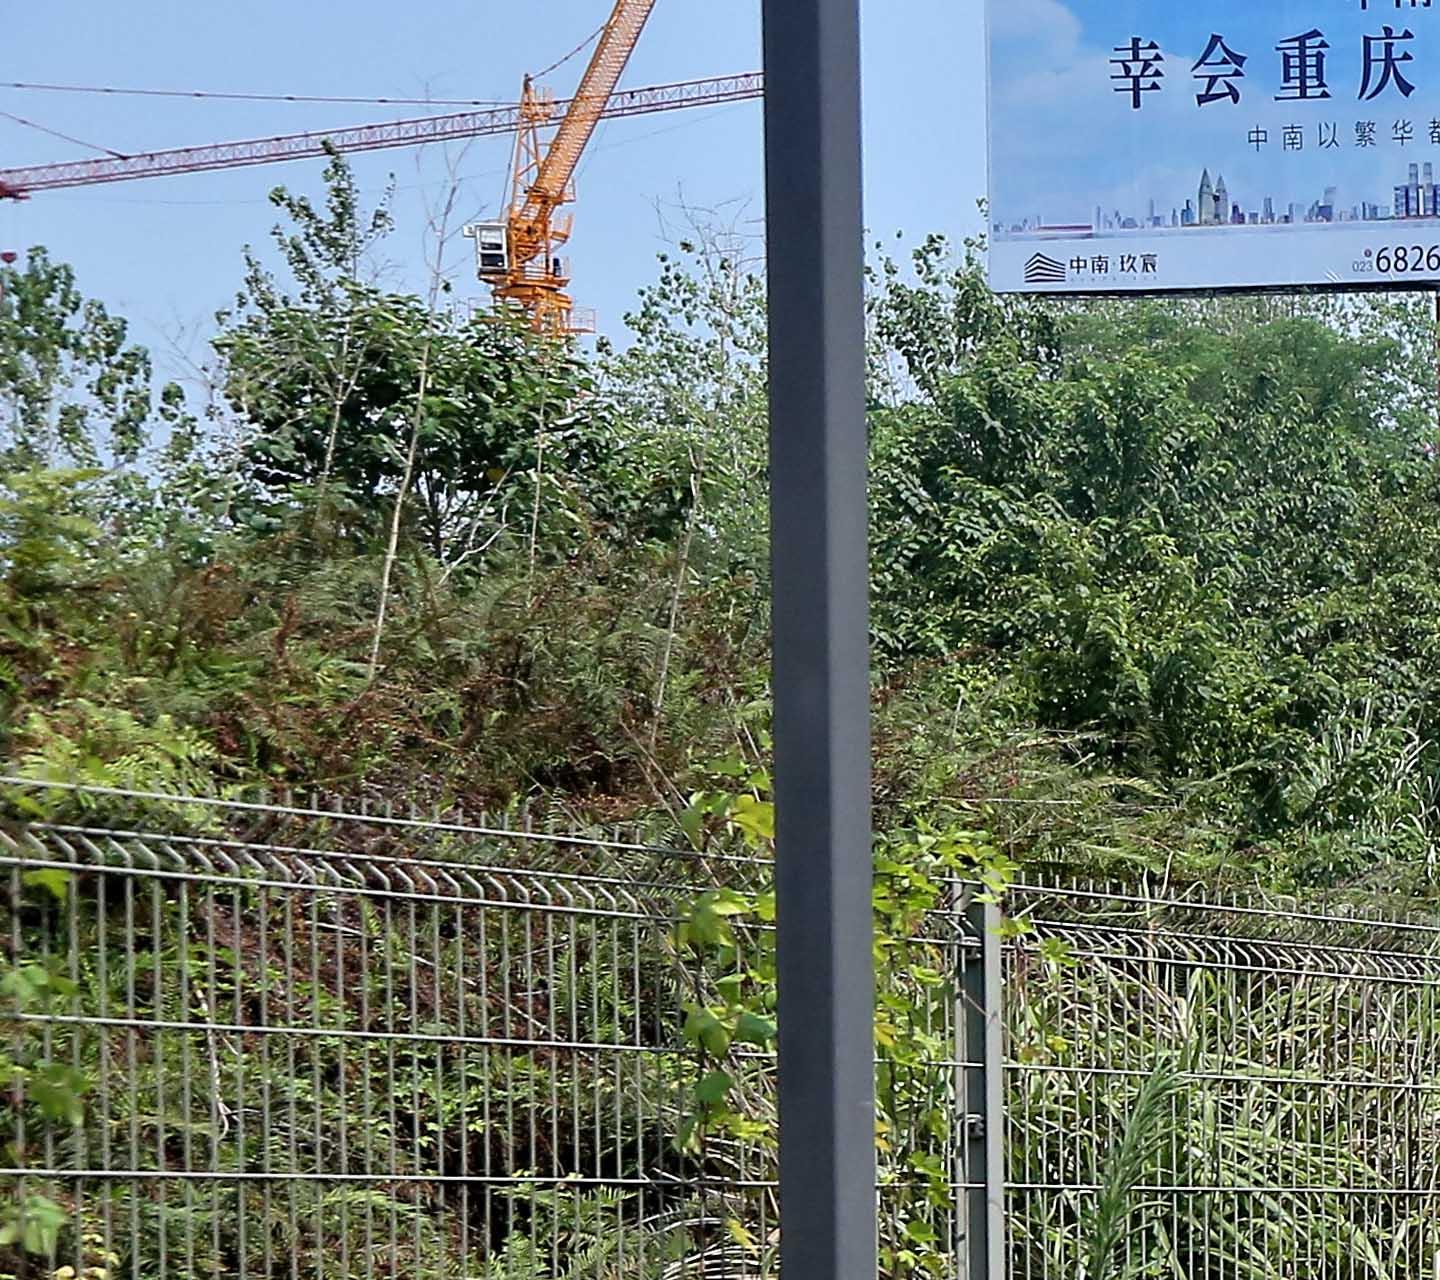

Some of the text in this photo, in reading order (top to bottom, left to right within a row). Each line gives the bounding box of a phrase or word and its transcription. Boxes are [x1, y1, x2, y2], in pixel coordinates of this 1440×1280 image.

[1109, 25, 1416, 109] 幸会重庆
[1352, 260, 1373, 273] 023
[1375, 244, 1440, 273] 6826
